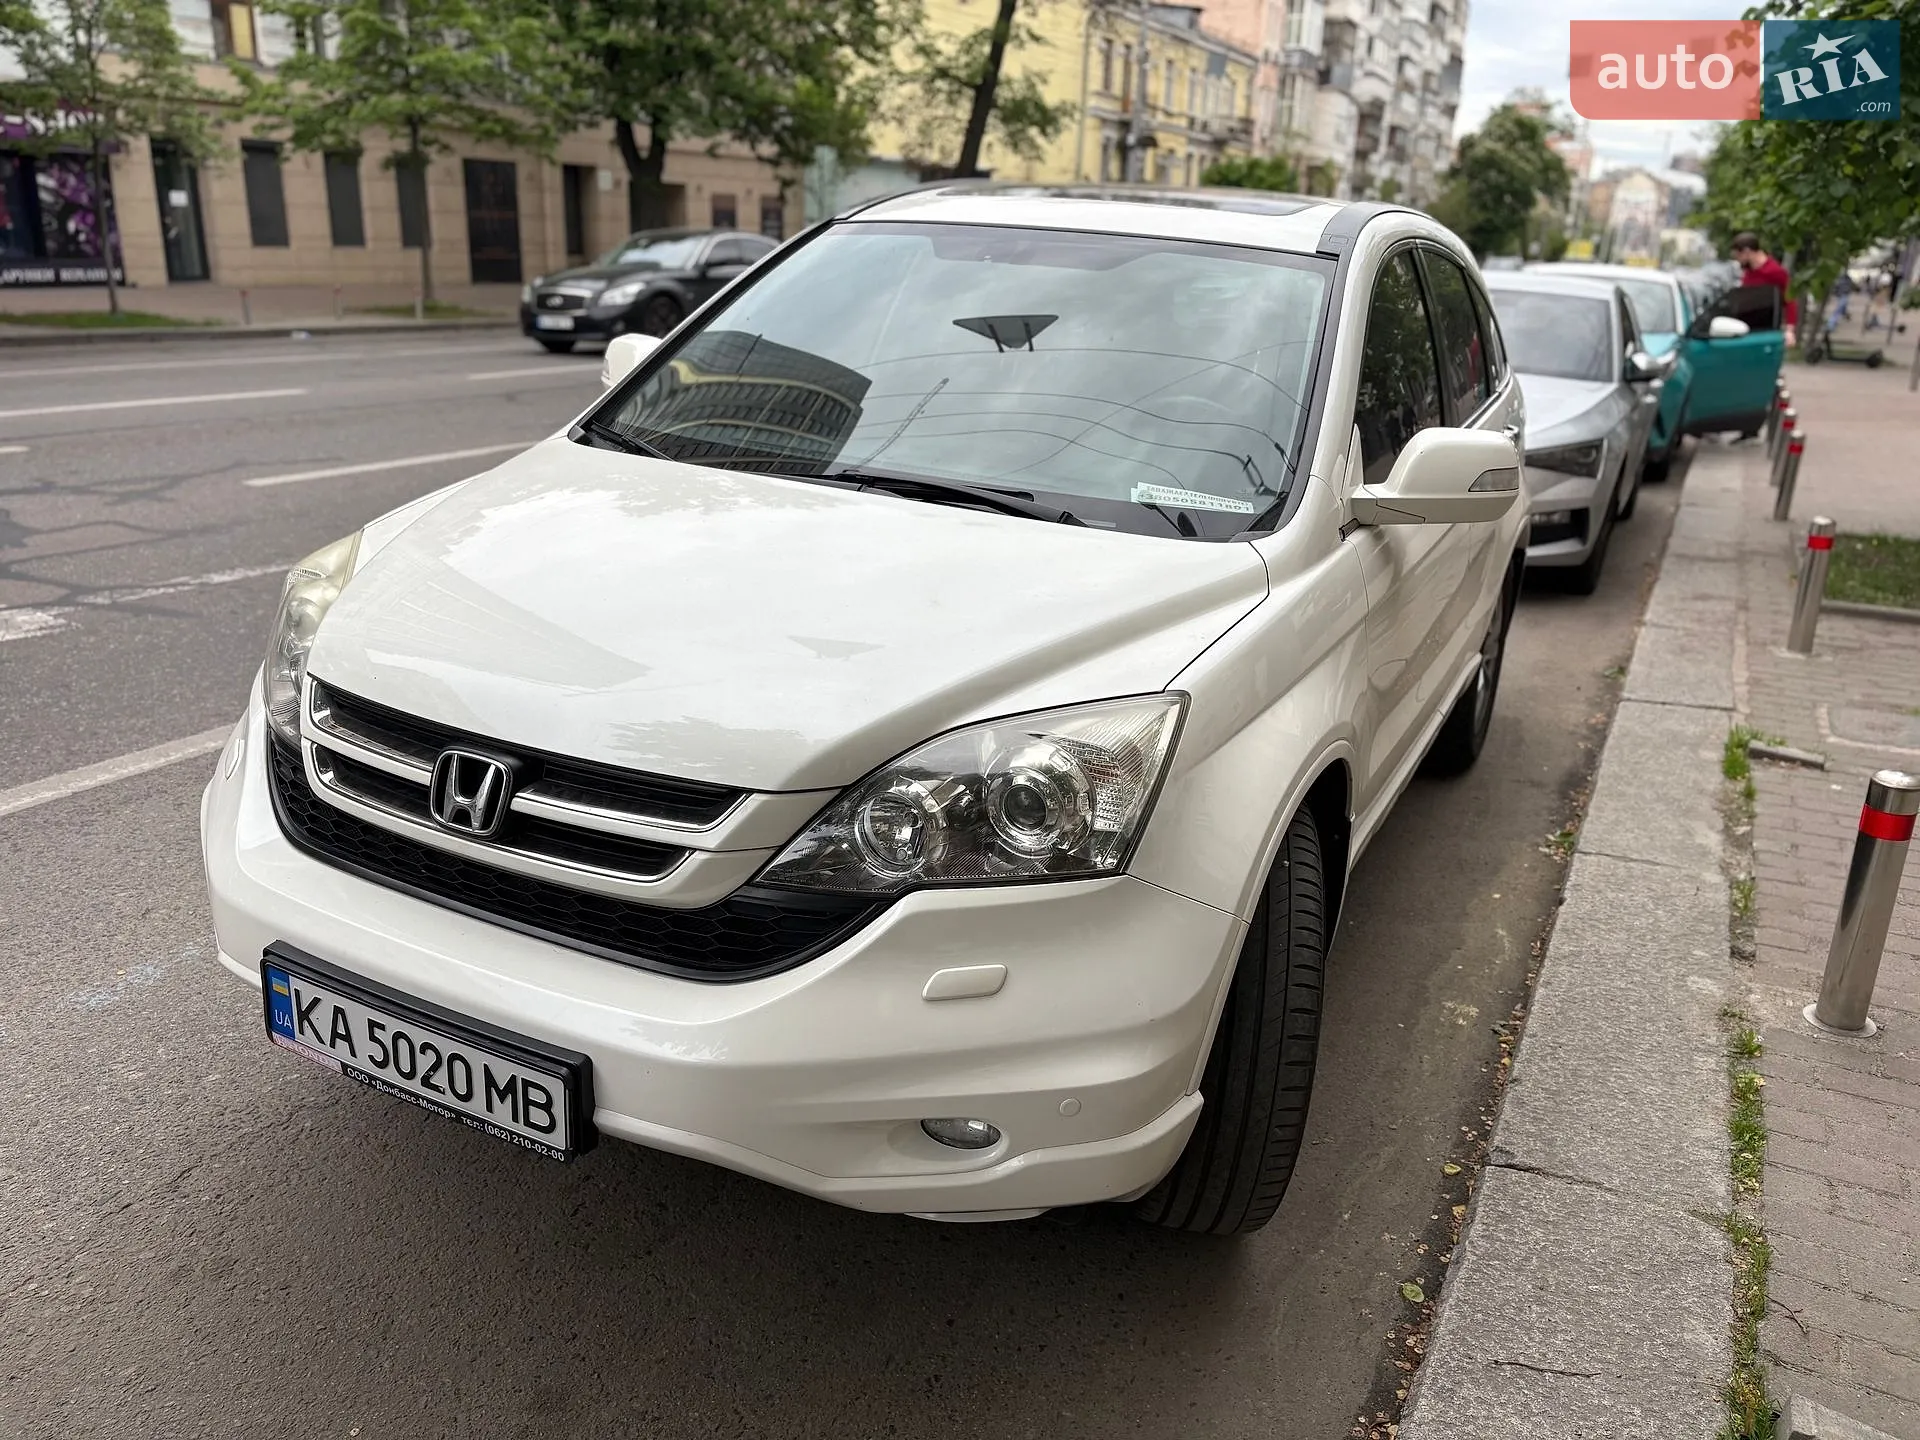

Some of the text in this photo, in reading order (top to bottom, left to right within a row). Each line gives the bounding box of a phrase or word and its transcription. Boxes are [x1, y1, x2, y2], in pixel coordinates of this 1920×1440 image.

[275, 1009, 293, 1030] UA
[367, 1018, 474, 1103] 5020
[484, 1122, 511, 1142] (062)
[512, 1134, 564, 1162] 210-02-00
